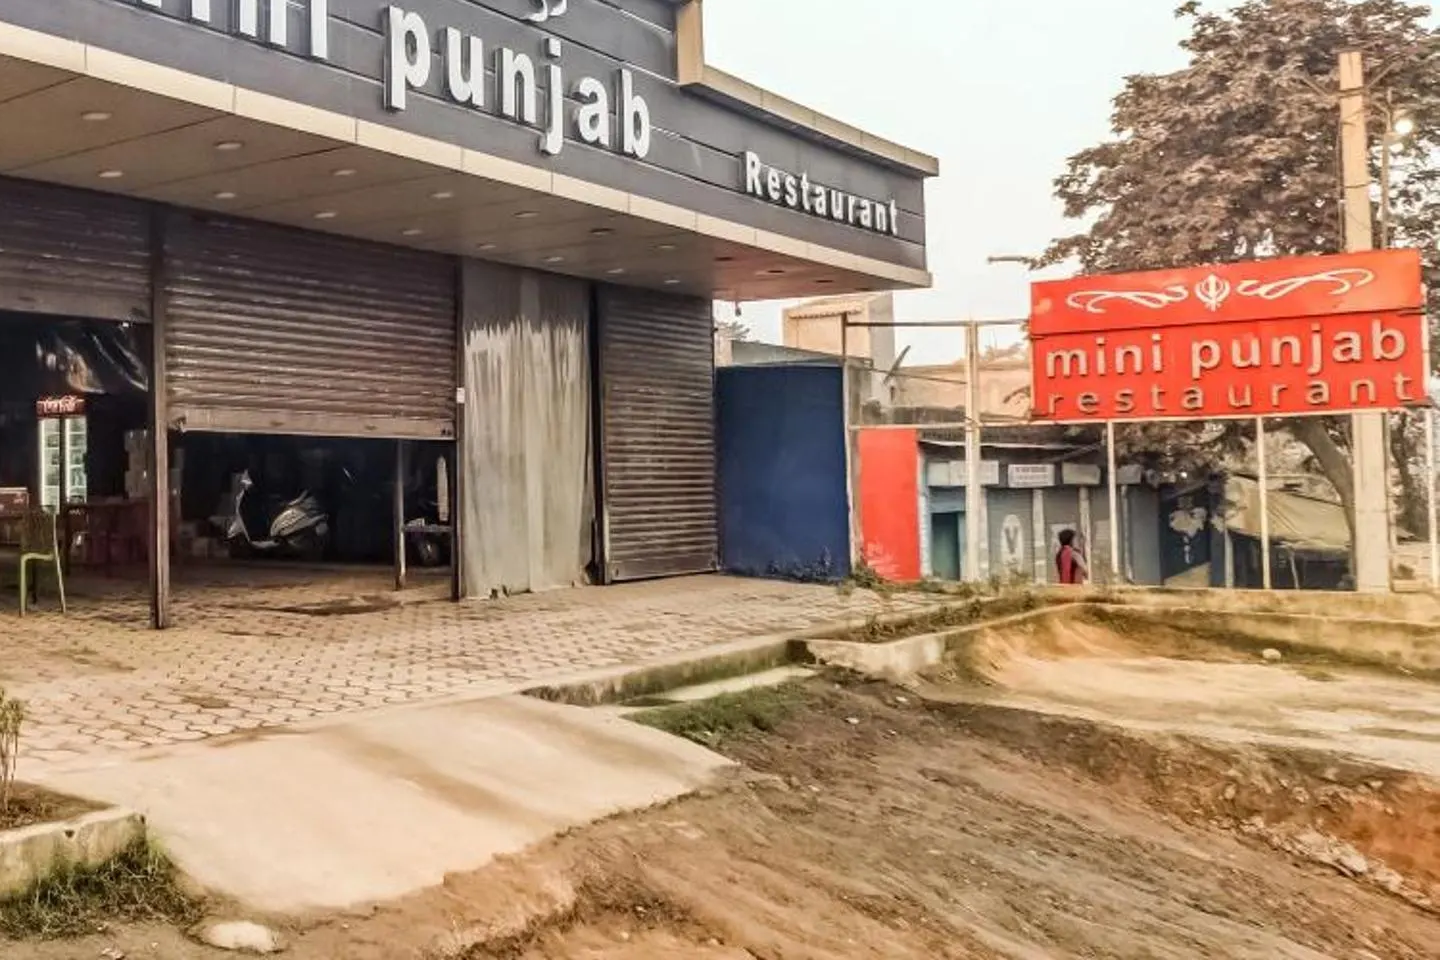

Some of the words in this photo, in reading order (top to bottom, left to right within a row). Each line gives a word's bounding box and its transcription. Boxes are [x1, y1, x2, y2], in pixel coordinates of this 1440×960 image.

[385, 5, 650, 157] punjab
[745, 151, 898, 235] Restaurant
[1045, 334, 1163, 378] mini
[1190, 320, 1407, 379] punjab
[1047, 374, 1415, 415] restaurant
